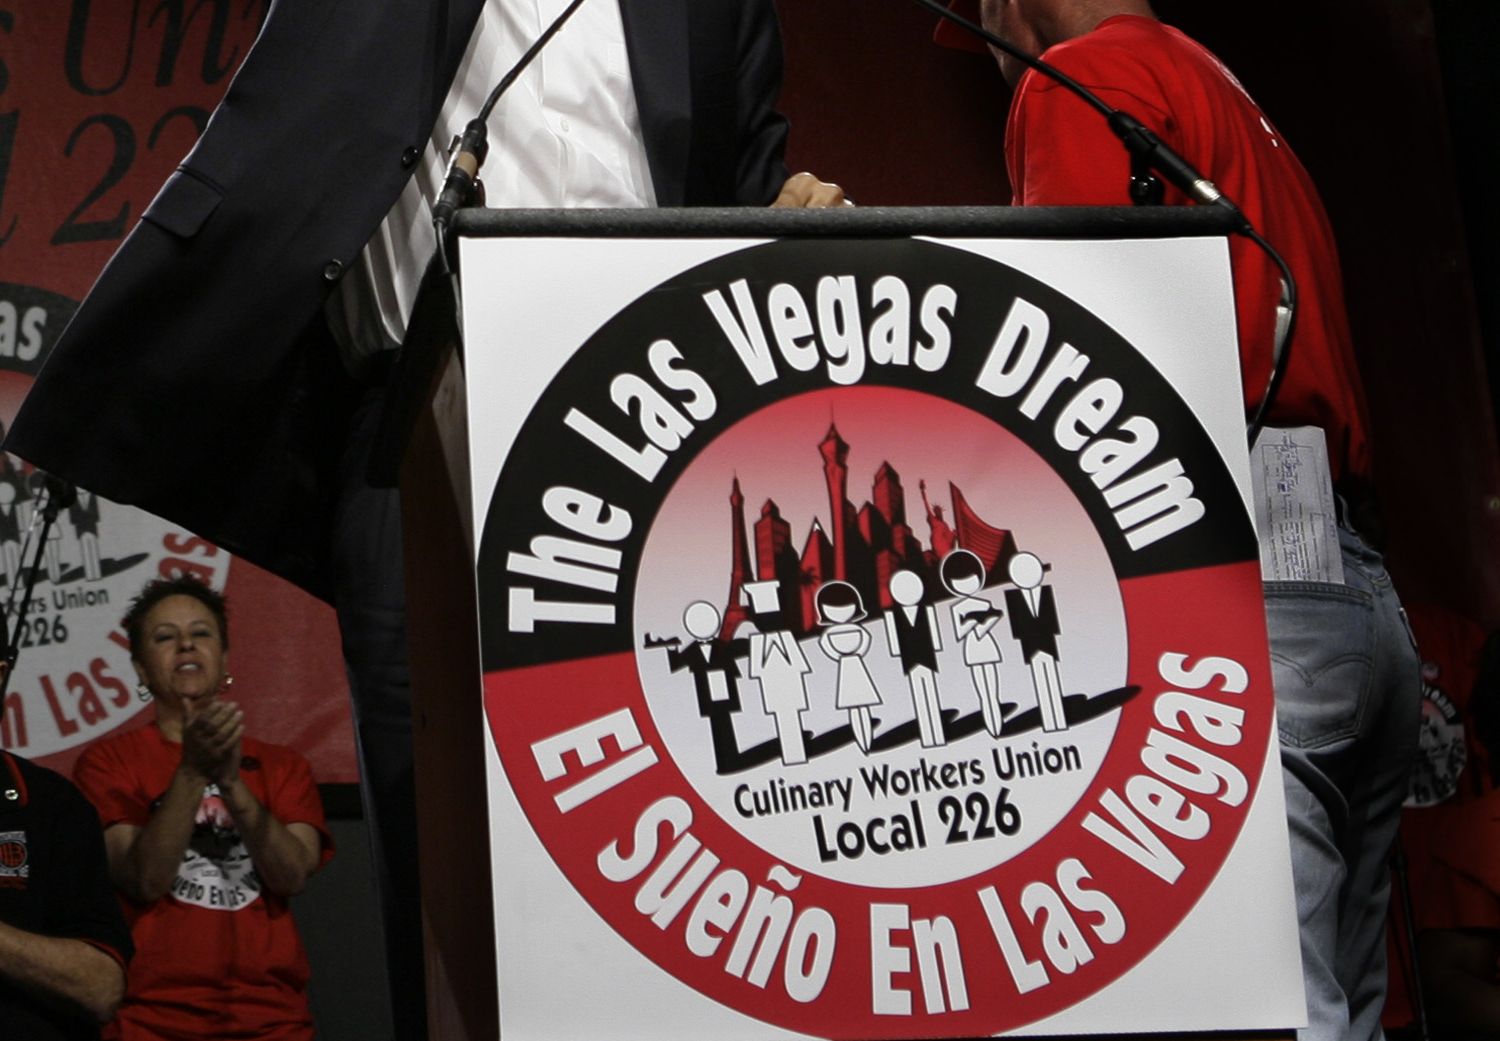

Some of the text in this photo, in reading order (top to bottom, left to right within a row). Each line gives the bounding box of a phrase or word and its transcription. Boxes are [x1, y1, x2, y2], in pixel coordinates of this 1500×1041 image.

[703, 275, 958, 385] Vegas
[563, 339, 717, 483] Las
[975, 297, 1206, 552] Dream
[52, 588, 110, 610] Union
[507, 484, 633, 633] The
[20, 615, 68, 649] 226
[39, 658, 130, 737] Las
[733, 739, 1082, 819] Culinary Workers Union
[530, 651, 1250, 1015] El Sueño En Las Vegas
[814, 792, 1022, 863] Local 226
